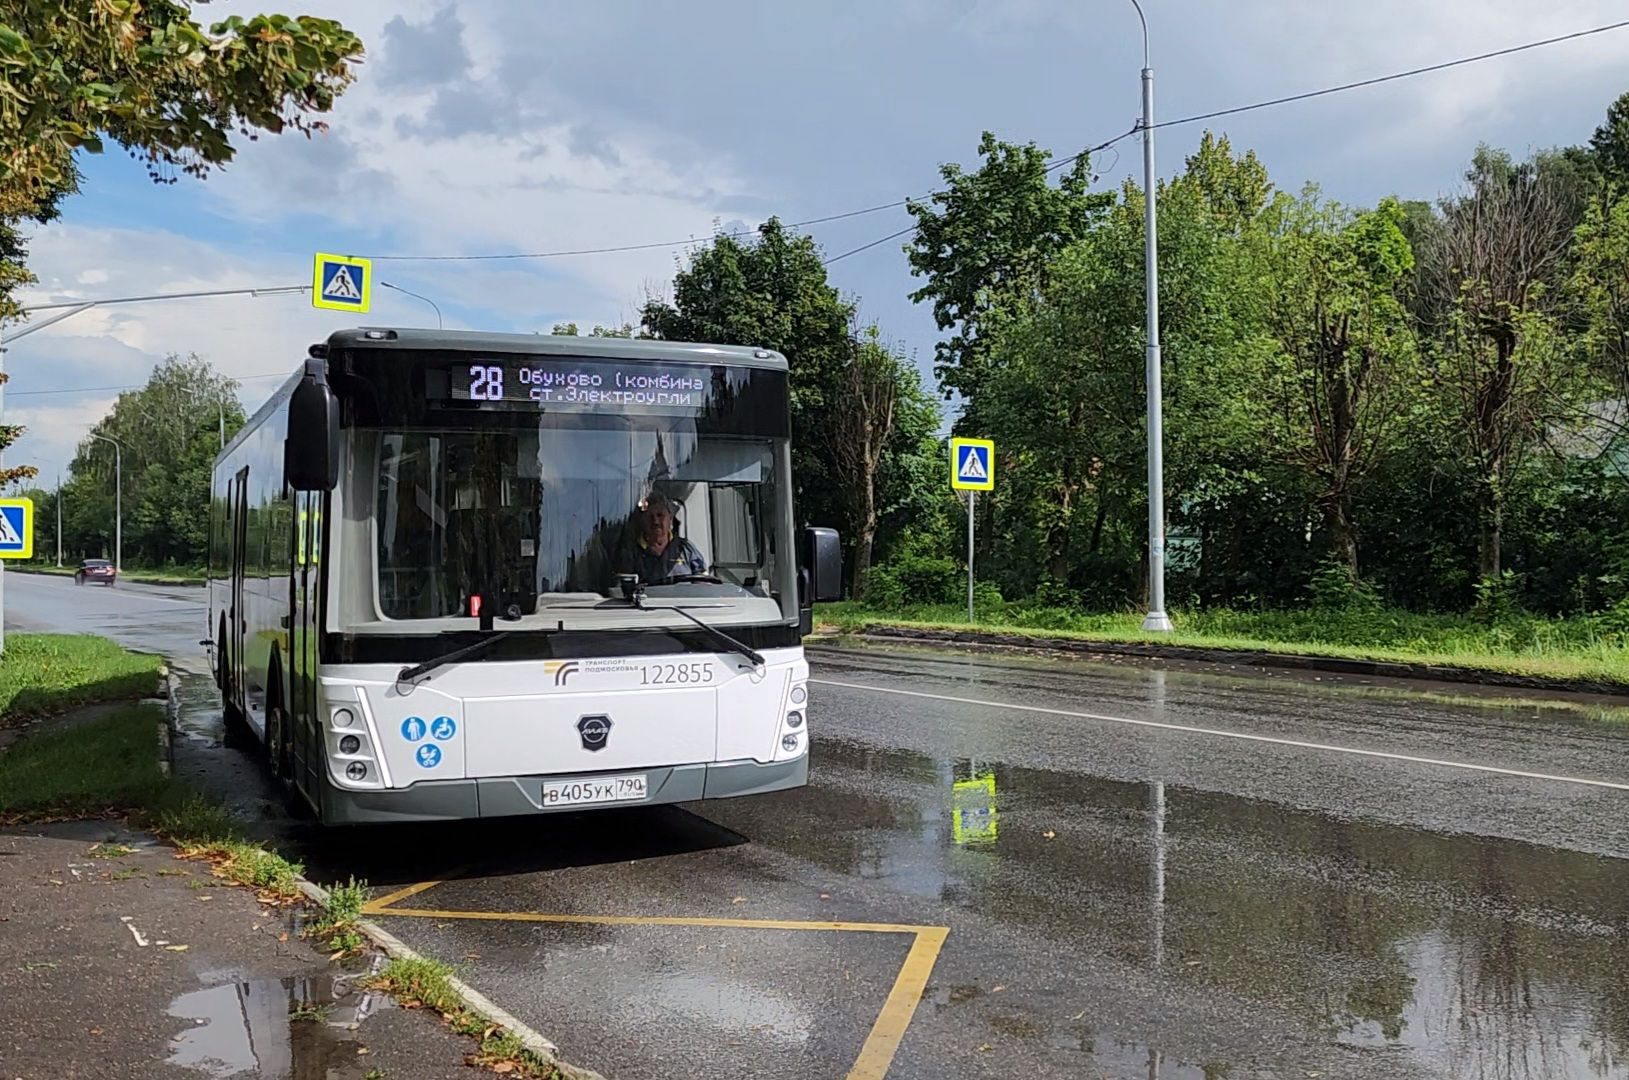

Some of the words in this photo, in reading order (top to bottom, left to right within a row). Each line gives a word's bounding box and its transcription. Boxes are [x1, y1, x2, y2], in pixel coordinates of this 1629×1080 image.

[469, 366, 503, 400] 28
[519, 367, 602, 387] Обухово
[615, 370, 704, 390] (комбина
[585, 665, 639, 673] ПОДМОСКОВЬЯ
[640, 663, 713, 685] 122855
